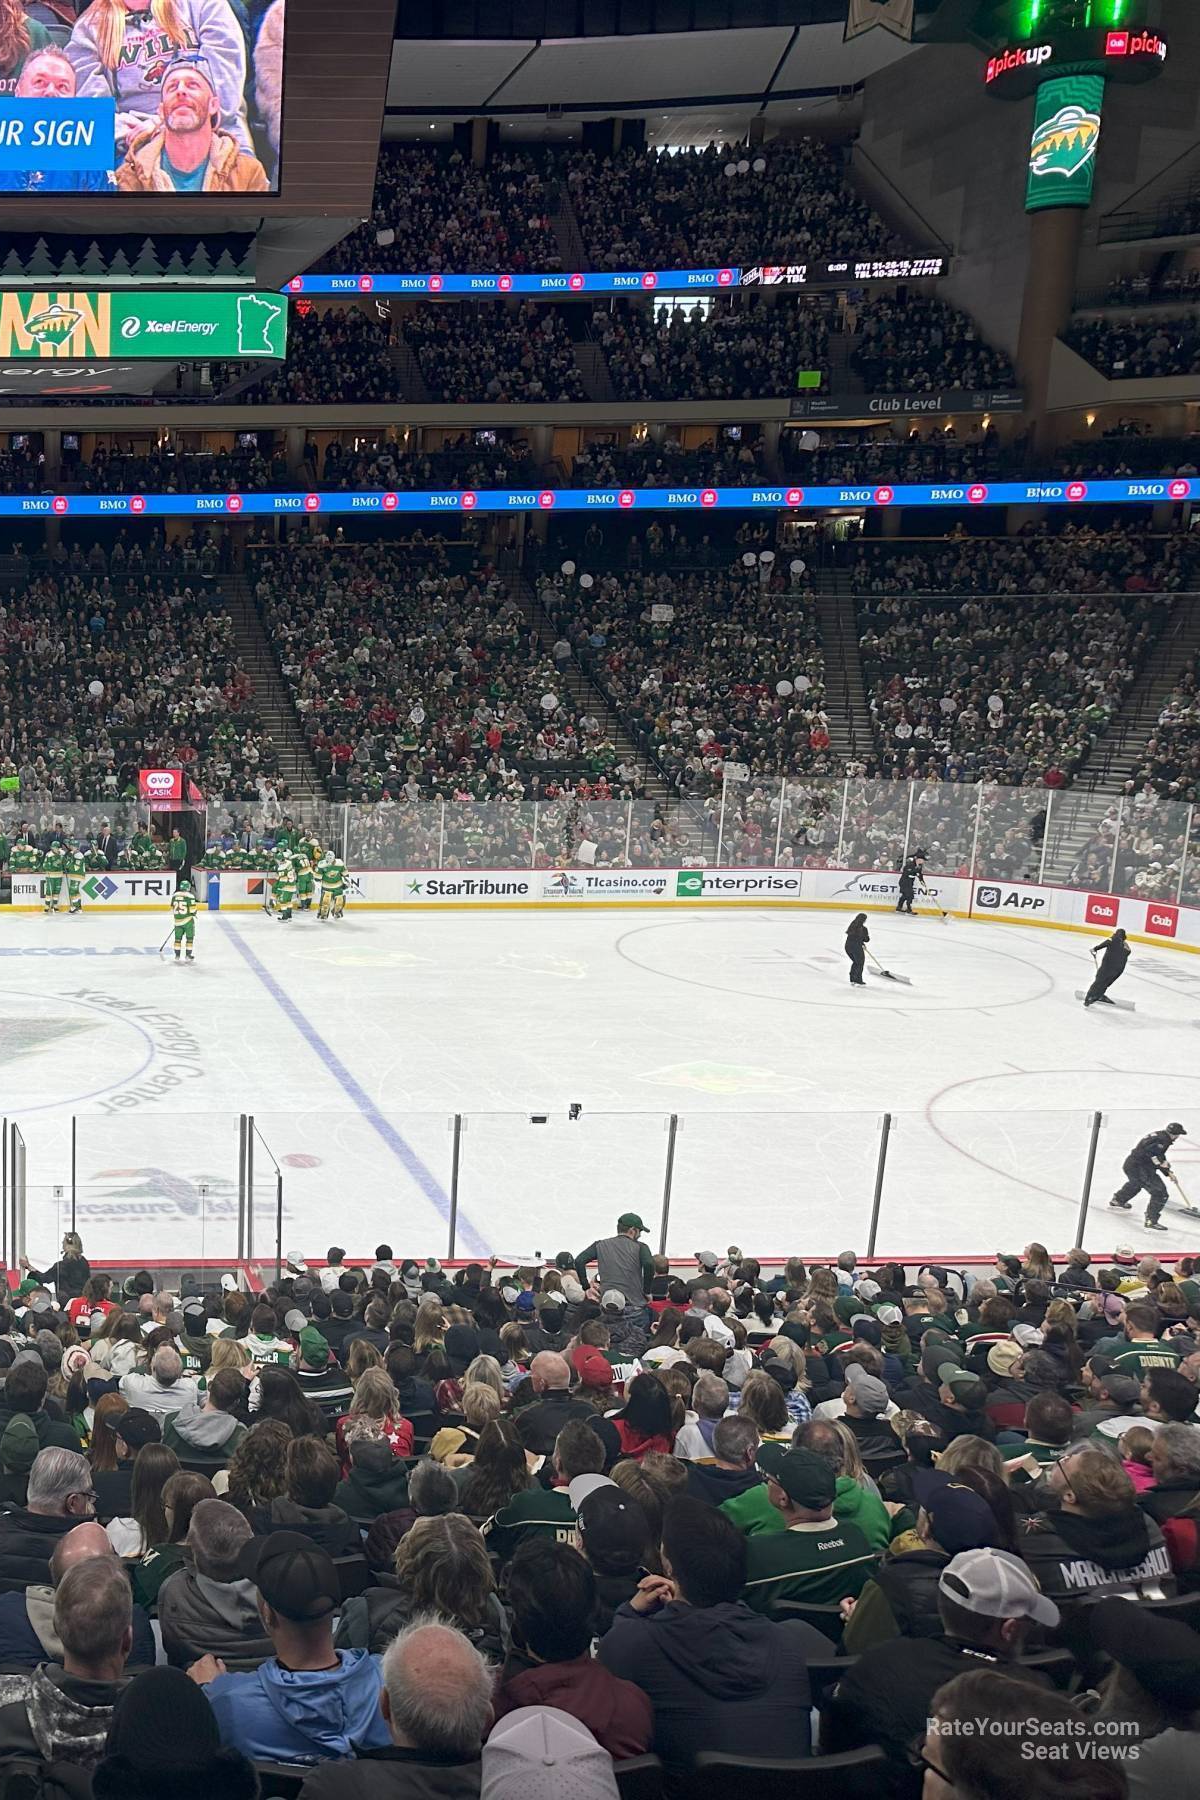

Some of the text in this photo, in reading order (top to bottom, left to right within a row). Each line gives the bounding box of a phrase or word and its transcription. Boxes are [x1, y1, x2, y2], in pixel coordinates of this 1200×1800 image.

[31, 119, 95, 146] SIGN
[331, 279, 356, 288] BMO
[401, 279, 425, 288] BMO
[471, 279, 495, 288] BMO
[541, 279, 567, 288] BMO
[614, 277, 639, 286] BMO
[688, 274, 714, 283] BMO
[869, 396, 942, 412] Club Level
[931, 489, 963, 499] BMO
[1027, 487, 1062, 498] BMO
[1129, 485, 1164, 495] BMO
[431, 496, 457, 506] BMO
[509, 495, 535, 505] BMO
[588, 494, 615, 504] BMO
[669, 493, 696, 503] BMO
[753, 492, 782, 502] BMO
[840, 491, 870, 501] BMO
[23, 501, 49, 510] BMO
[100, 500, 126, 509] BMO
[197, 499, 223, 508] BMO
[274, 498, 301, 507] BMO
[352, 497, 379, 506] BMO
[685, 875, 799, 892] enterprise
[859, 883, 939, 897] WEST END
[1092, 904, 1114, 918] Cub
[1151, 914, 1173, 928] Cub
[57, 987, 157, 1014] Xcel
[138, 1013, 202, 1062] Energy
[98, 1062, 206, 1117] Center
[817, 1539, 845, 1552] Reebok
